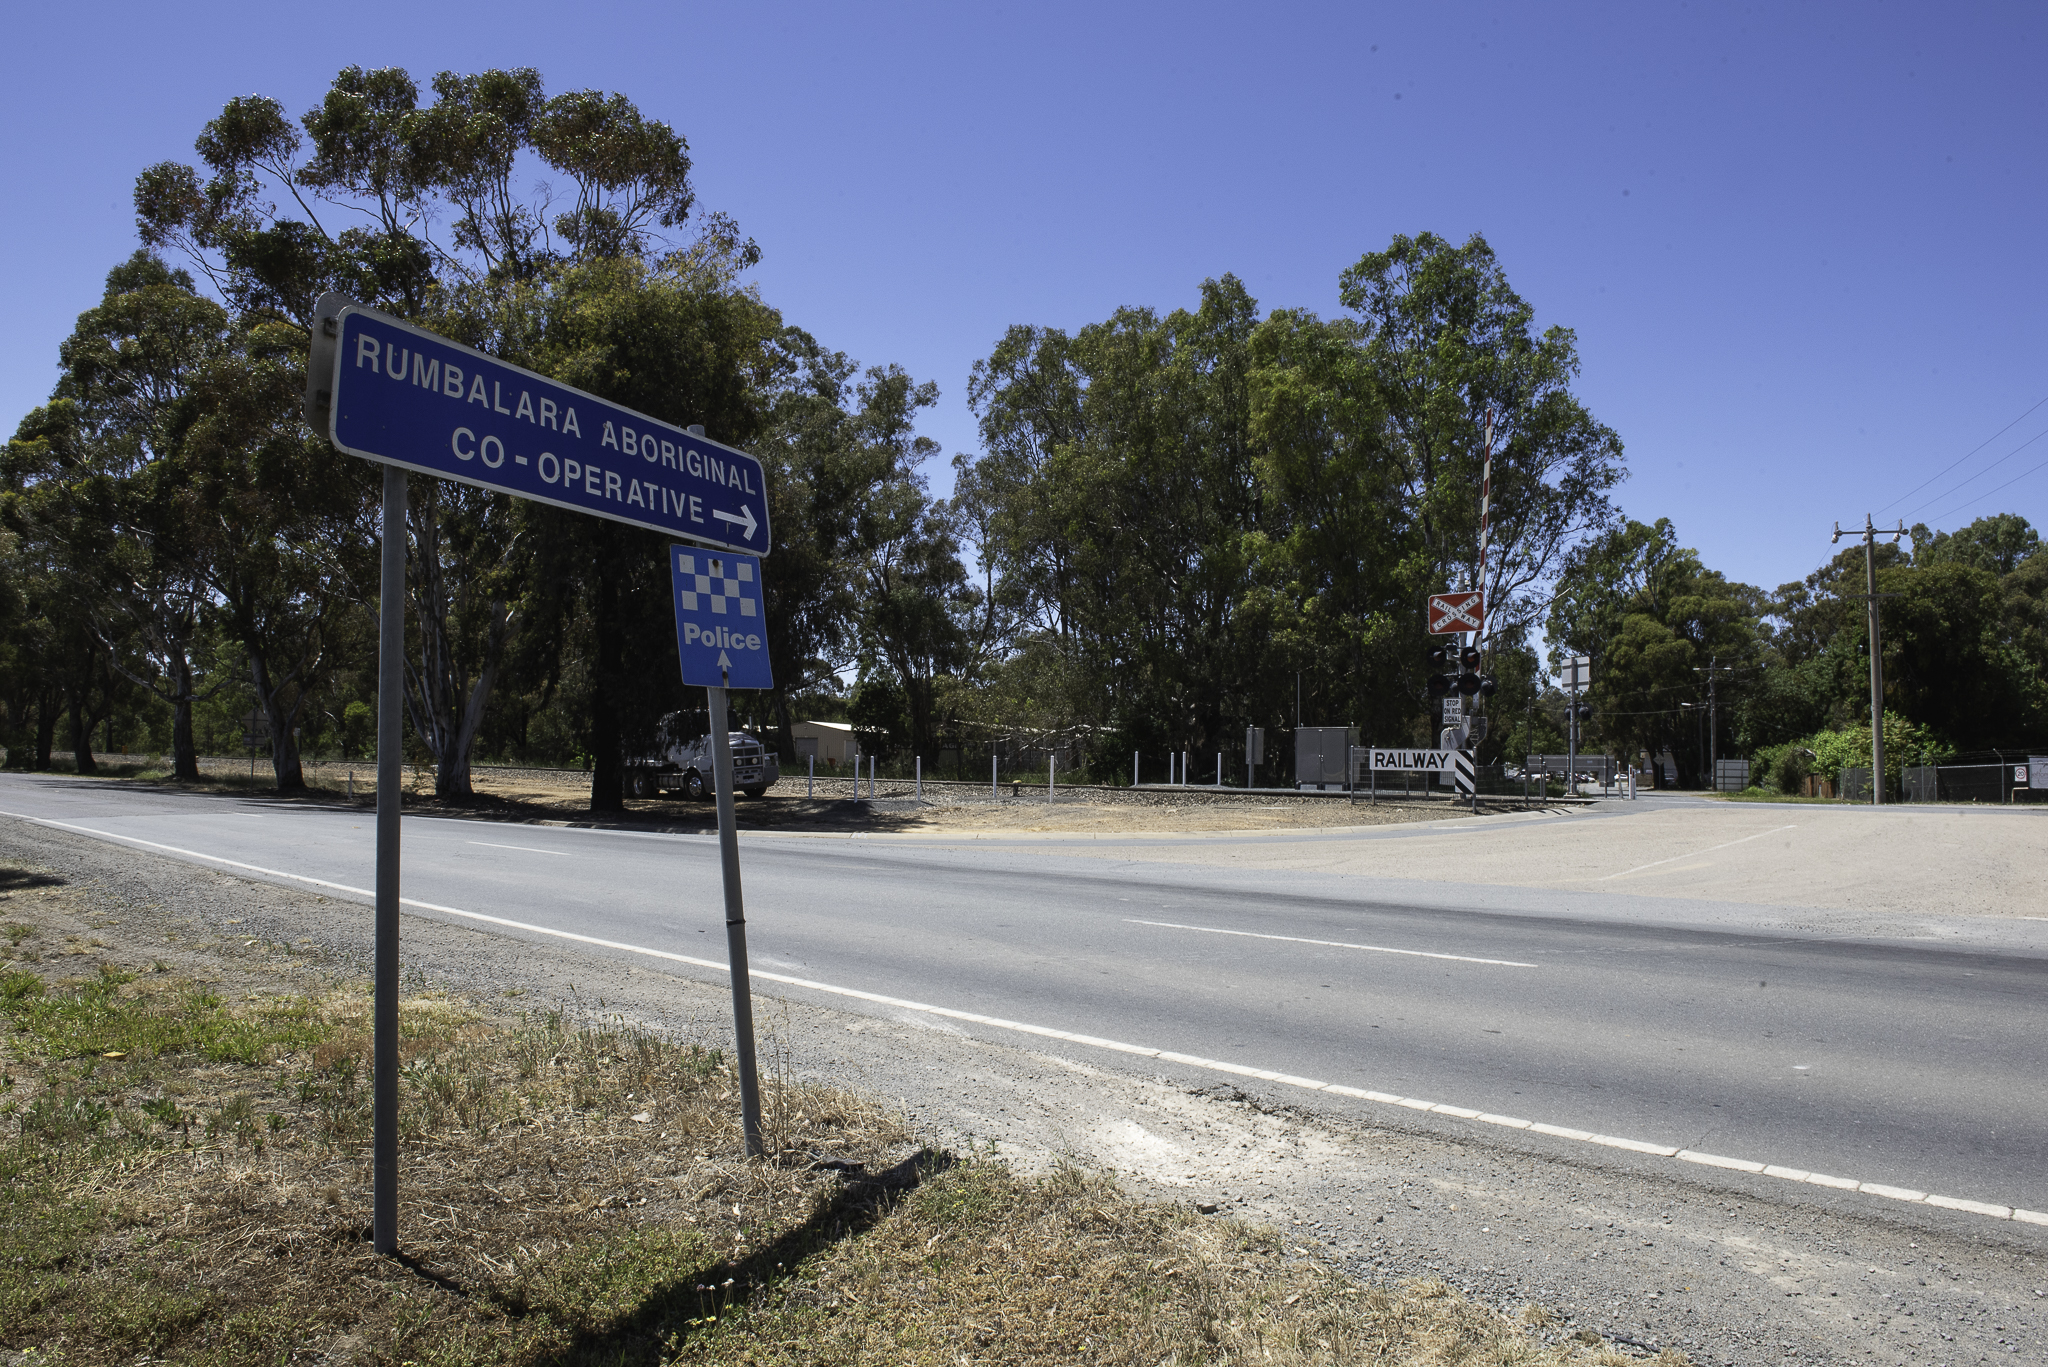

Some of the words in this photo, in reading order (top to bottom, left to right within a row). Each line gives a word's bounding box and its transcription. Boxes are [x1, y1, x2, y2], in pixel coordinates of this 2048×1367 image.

[357, 333, 581, 438] RUMBALARA
[601, 420, 757, 495] ABORIGINAL
[683, 622, 762, 650] Police
[1446, 699, 1459, 707] STOP
[1444, 715, 1461, 723] SIGNAL
[1375, 752, 1450, 768] RAILWAY
